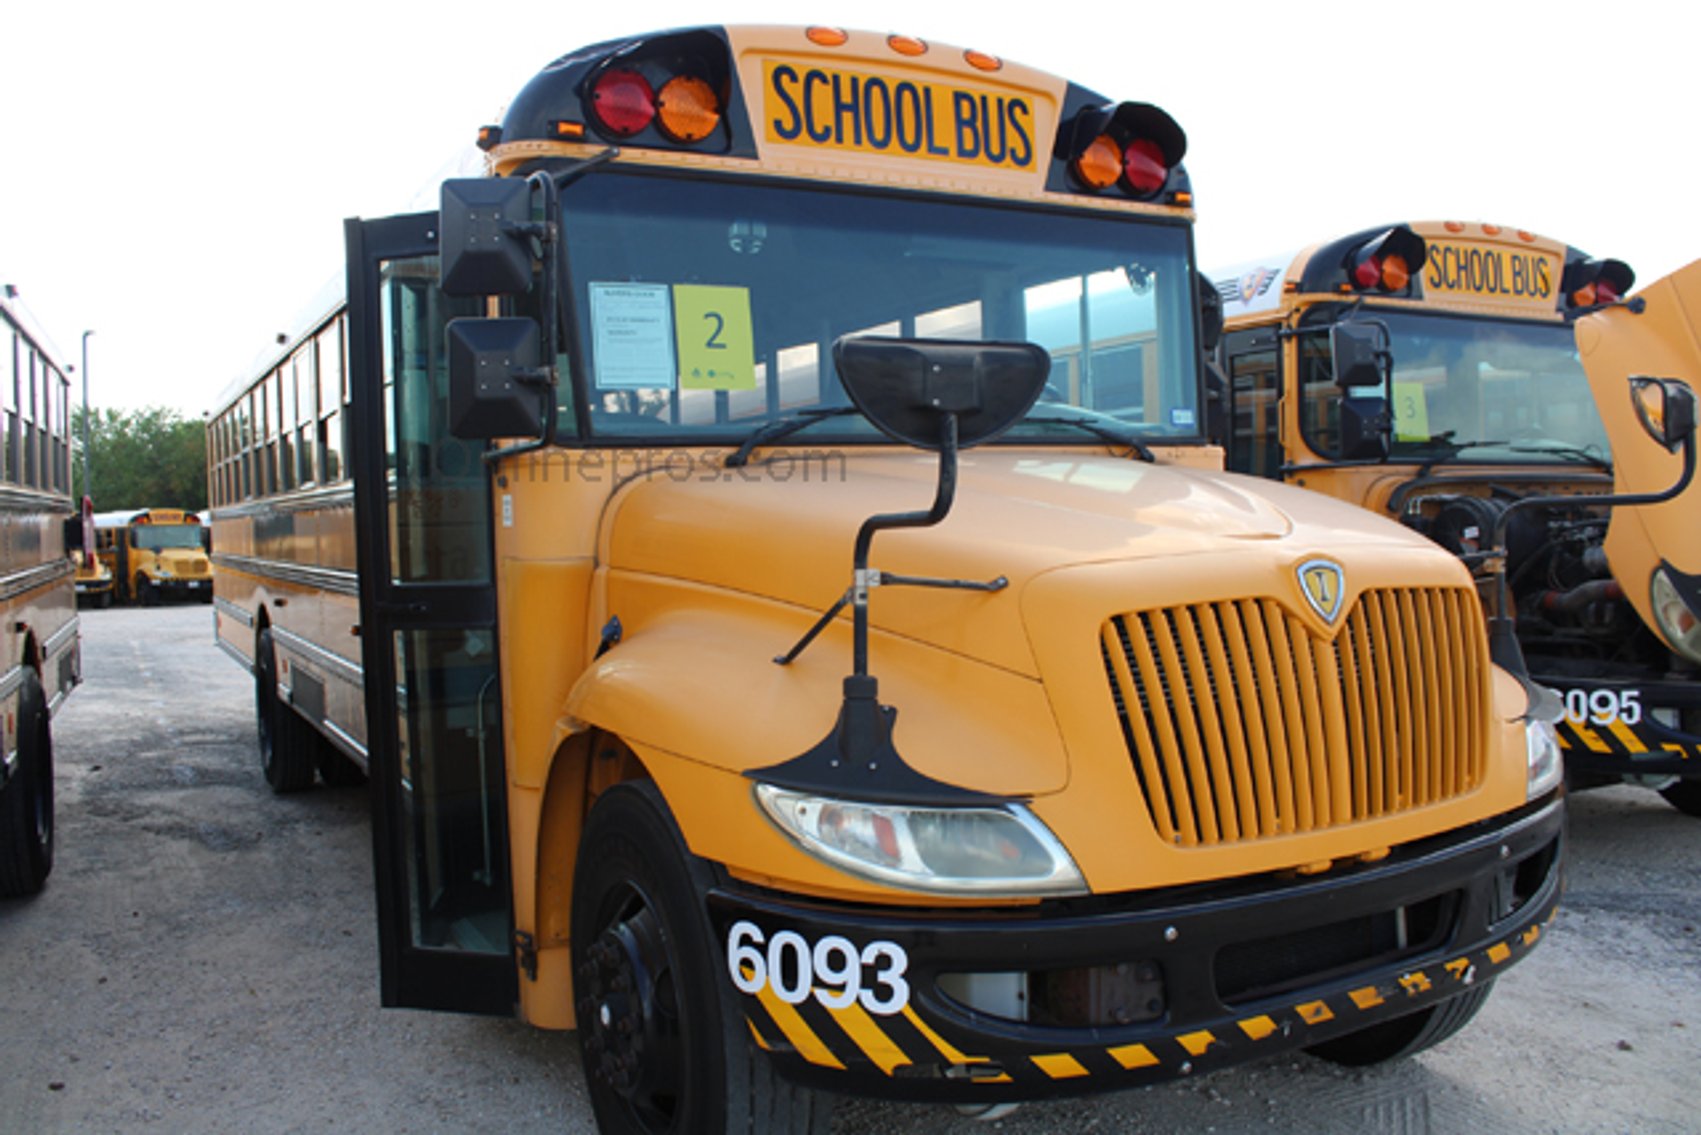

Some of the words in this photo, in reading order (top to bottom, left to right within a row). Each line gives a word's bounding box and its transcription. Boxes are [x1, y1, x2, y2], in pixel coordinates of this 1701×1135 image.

[772, 64, 949, 156] SCHOOL
[952, 90, 1033, 167] BUS
[1429, 244, 1510, 294] SCHOOL
[1512, 254, 1550, 298] BUS
[703, 311, 727, 349] 2
[1404, 396, 1416, 419] 3
[727, 920, 910, 1015] 6093
